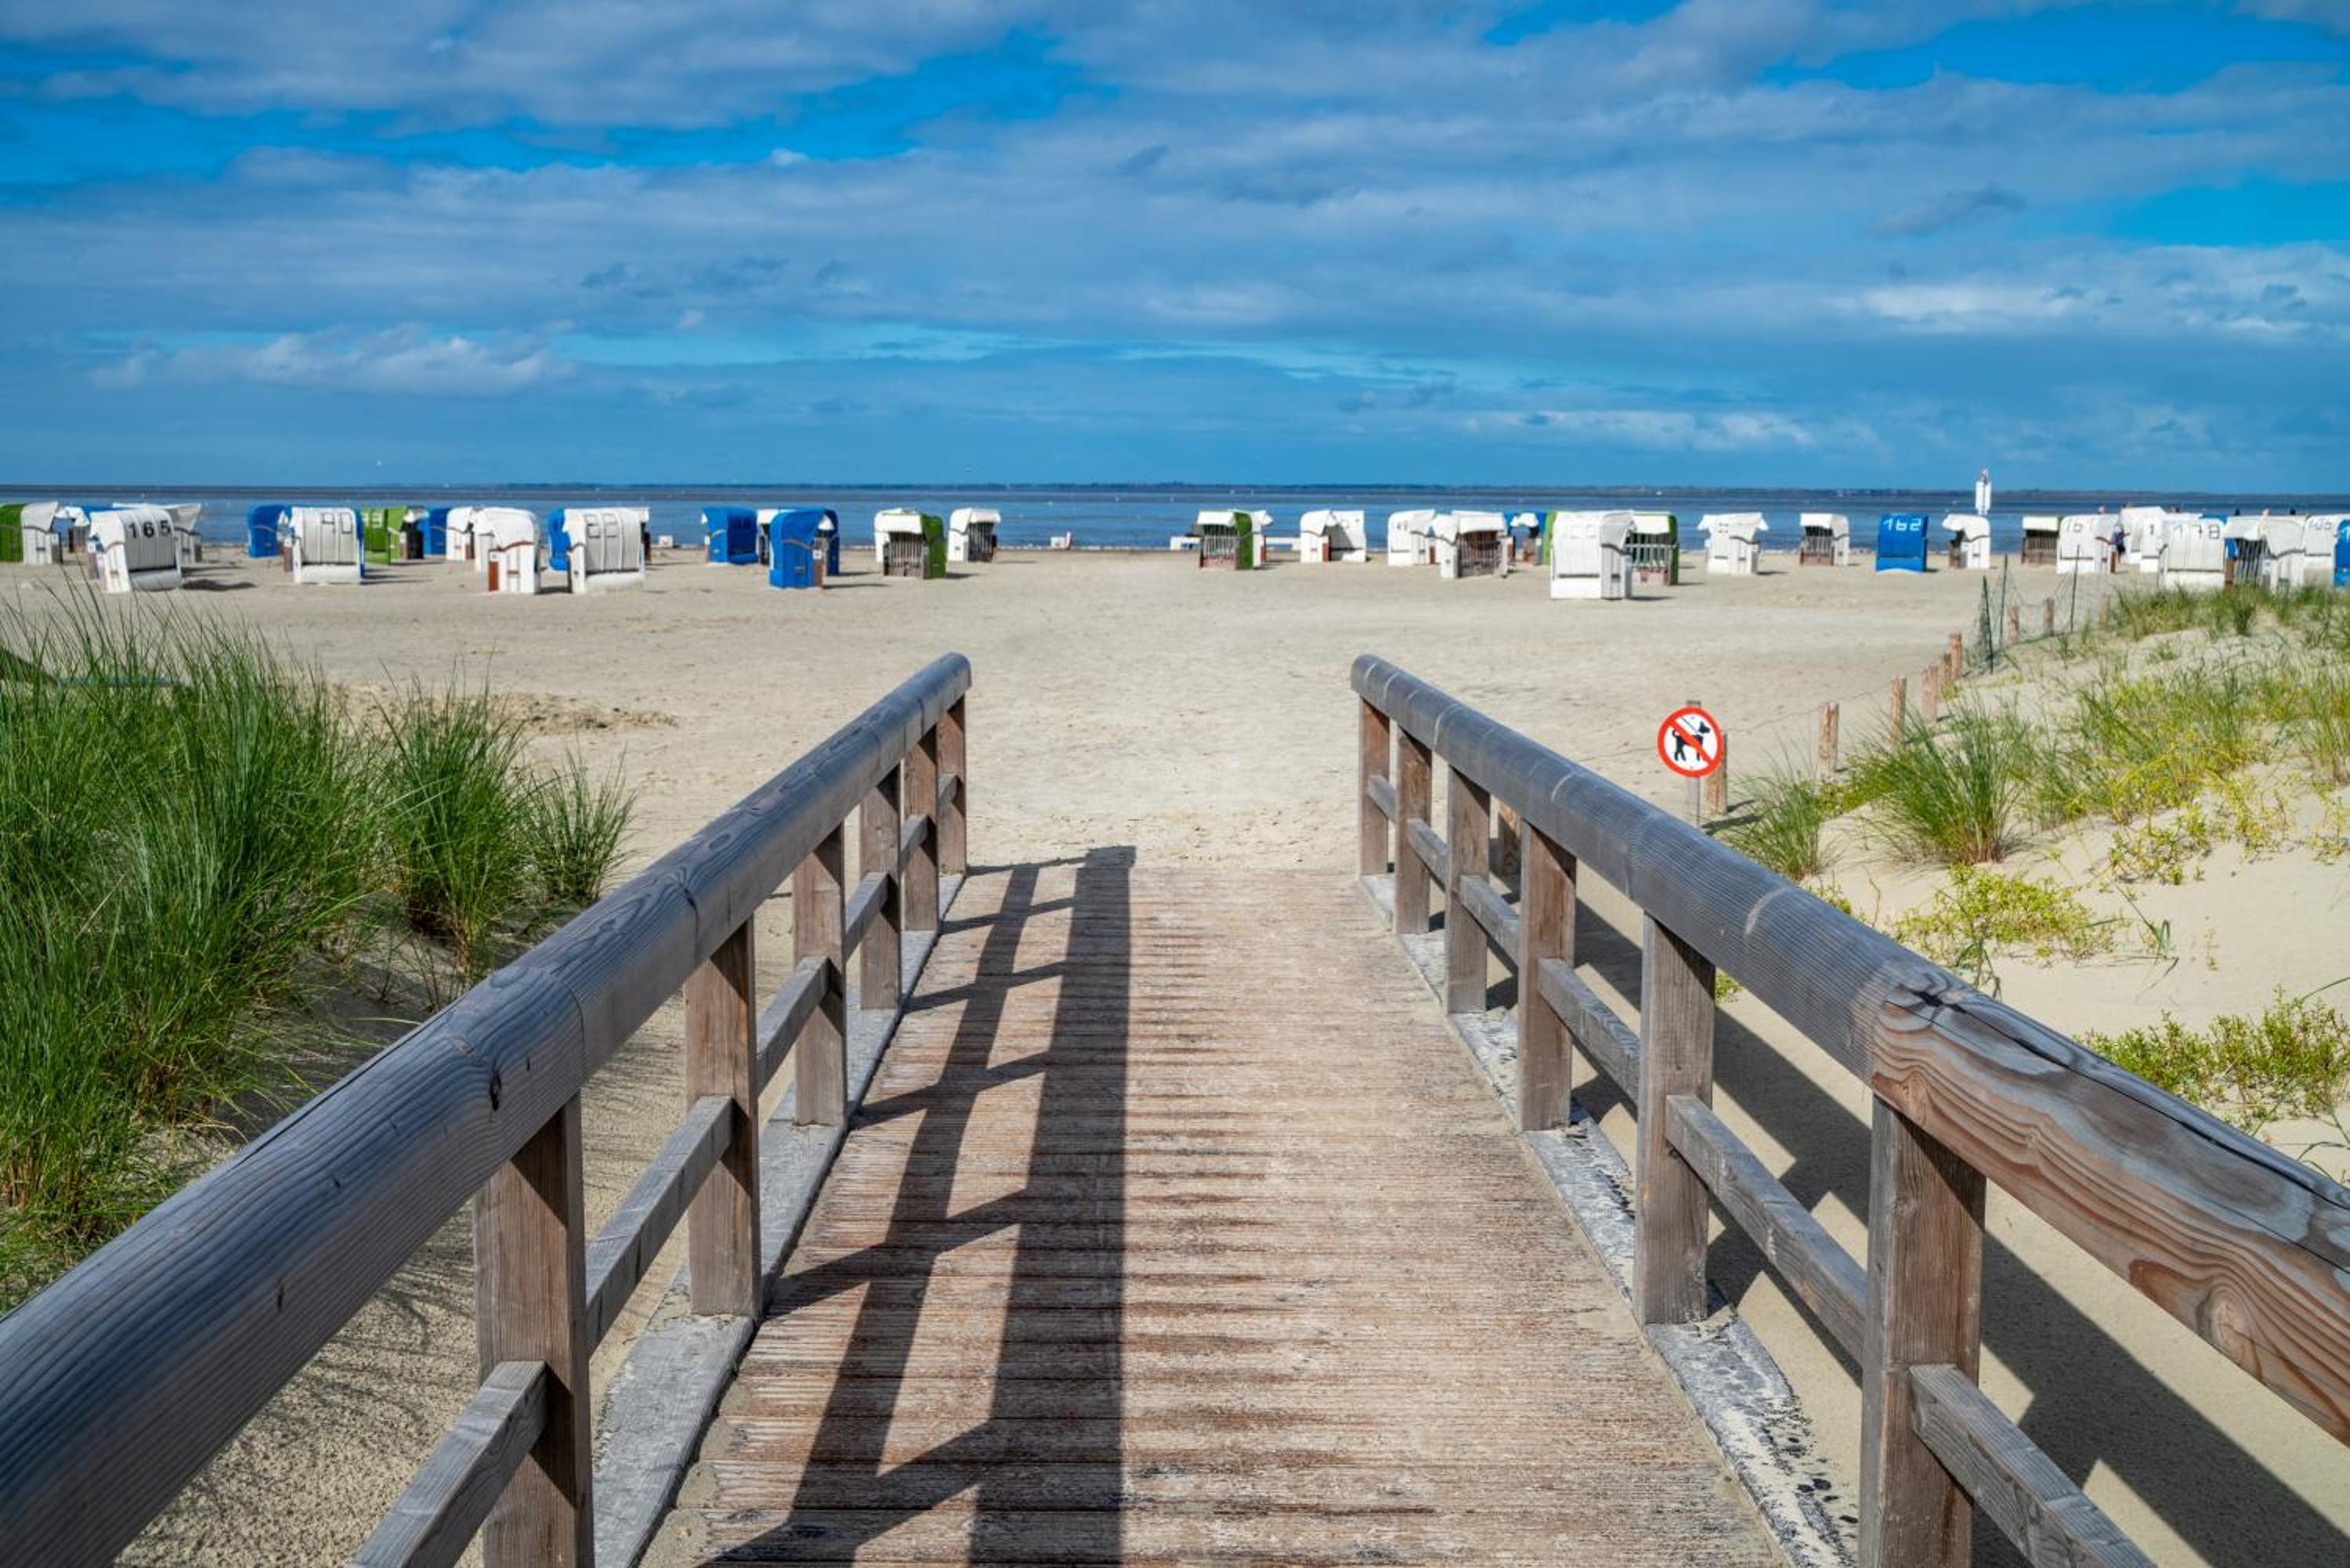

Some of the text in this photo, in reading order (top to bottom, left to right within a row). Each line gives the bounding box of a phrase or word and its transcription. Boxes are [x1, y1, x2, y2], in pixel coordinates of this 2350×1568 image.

[128, 520, 171, 539] 165
[1882, 518, 1922, 531] 162
[2172, 523, 2221, 540] 178
